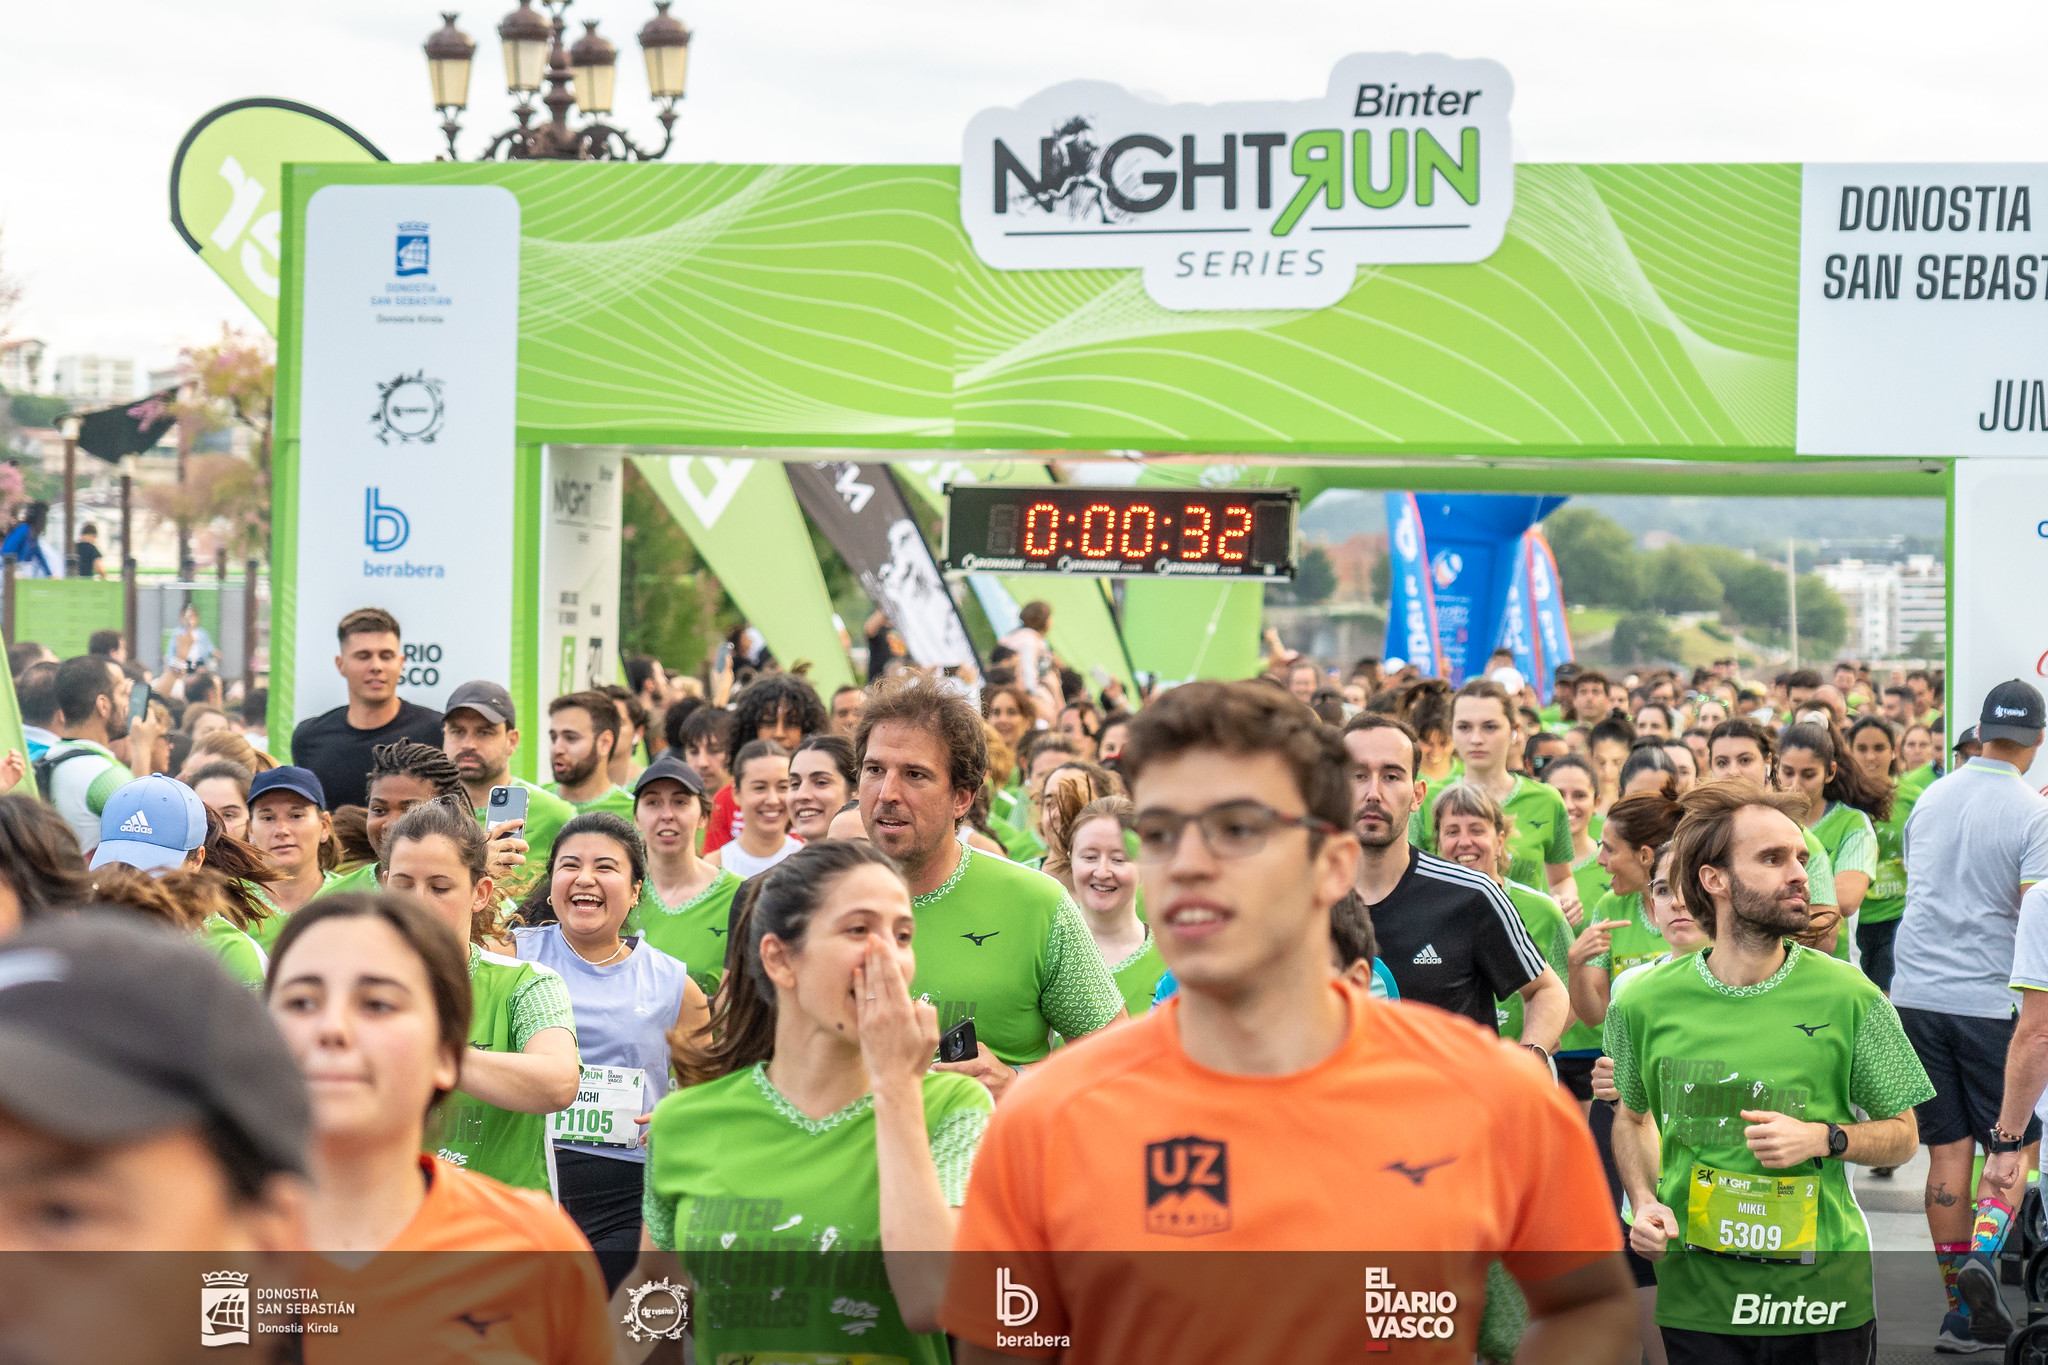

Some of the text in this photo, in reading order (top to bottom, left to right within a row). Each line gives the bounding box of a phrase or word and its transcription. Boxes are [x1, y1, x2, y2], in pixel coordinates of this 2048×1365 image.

[1354, 84, 1482, 117] Binter
[1839, 185, 2032, 232] DONOSTIA
[1176, 249, 1327, 278] SERIES
[1823, 254, 1903, 300] SAN
[1025, 503, 1252, 560] 0:00:32
[364, 560, 445, 579] berabera
[120, 823, 153, 835] adidas
[1413, 956, 1442, 965] adidas
[633, 1076, 639, 1088] 4
[574, 1091, 599, 1103] ACHI
[555, 1107, 613, 1134] F1105
[436, 1148, 469, 1166] 2025
[1153, 1147, 1221, 1187] UZ
[1806, 1184, 1814, 1197] 2
[1738, 1202, 1767, 1216] MIKEL
[1720, 1219, 1782, 1250] 5309
[830, 1296, 881, 1319] 2025
